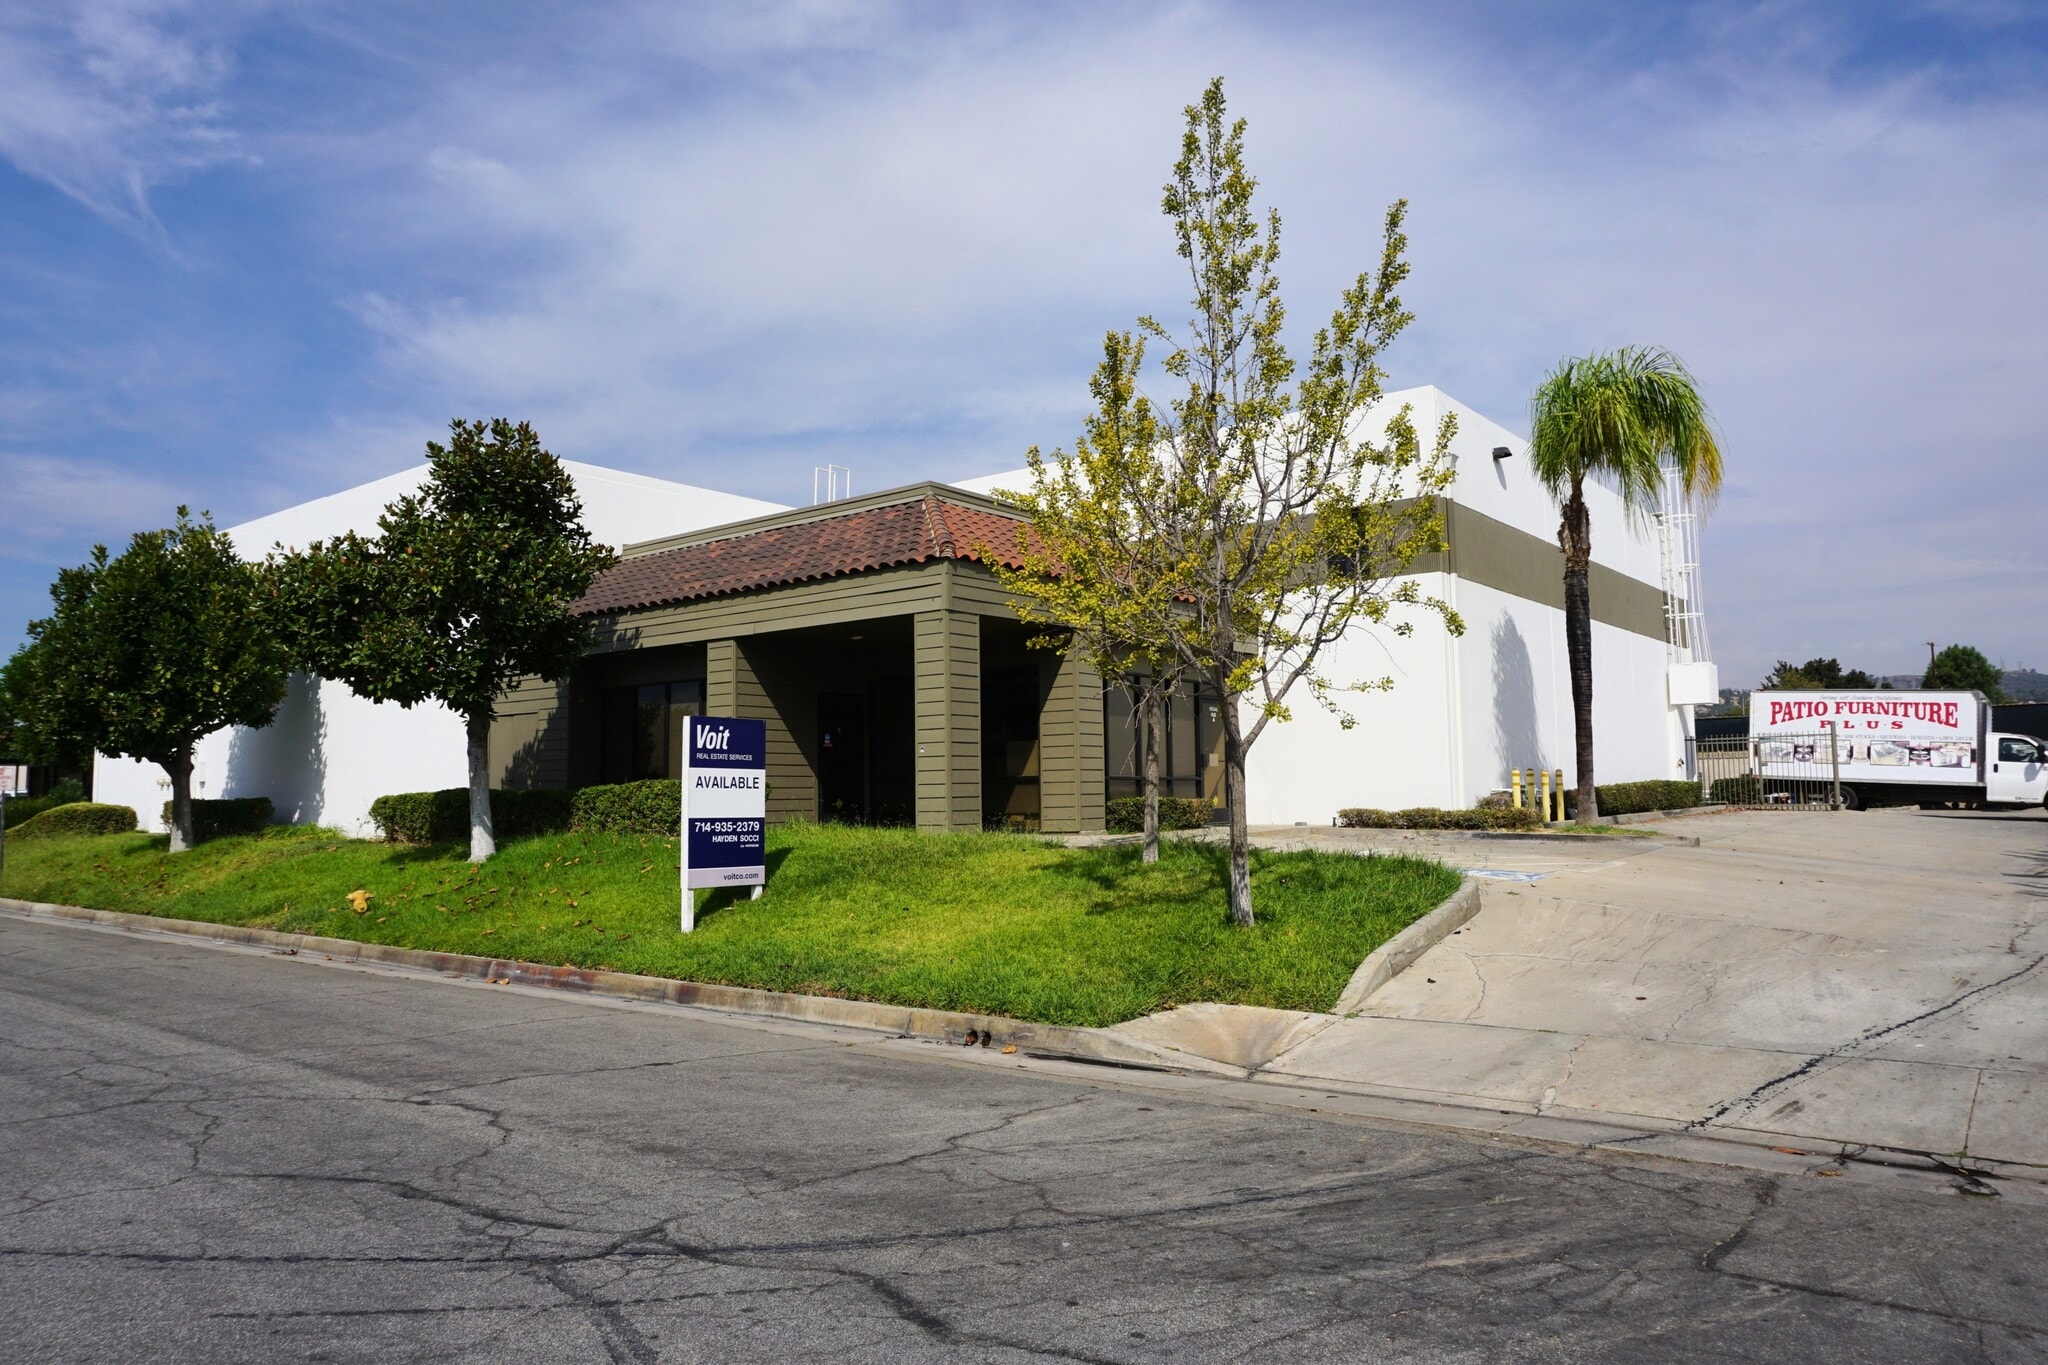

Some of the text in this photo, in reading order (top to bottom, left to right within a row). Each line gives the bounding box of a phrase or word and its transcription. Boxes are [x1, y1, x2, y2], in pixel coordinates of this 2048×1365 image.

[1770, 701, 1958, 729] PATIO FURNITURE
[696, 724, 730, 750] Voit
[696, 776, 760, 789] AVAILABLE
[694, 822, 760, 833] 714-935-2379
[712, 834, 759, 843] HAYDEN SOCCI
[723, 872, 759, 881] voitco.com
